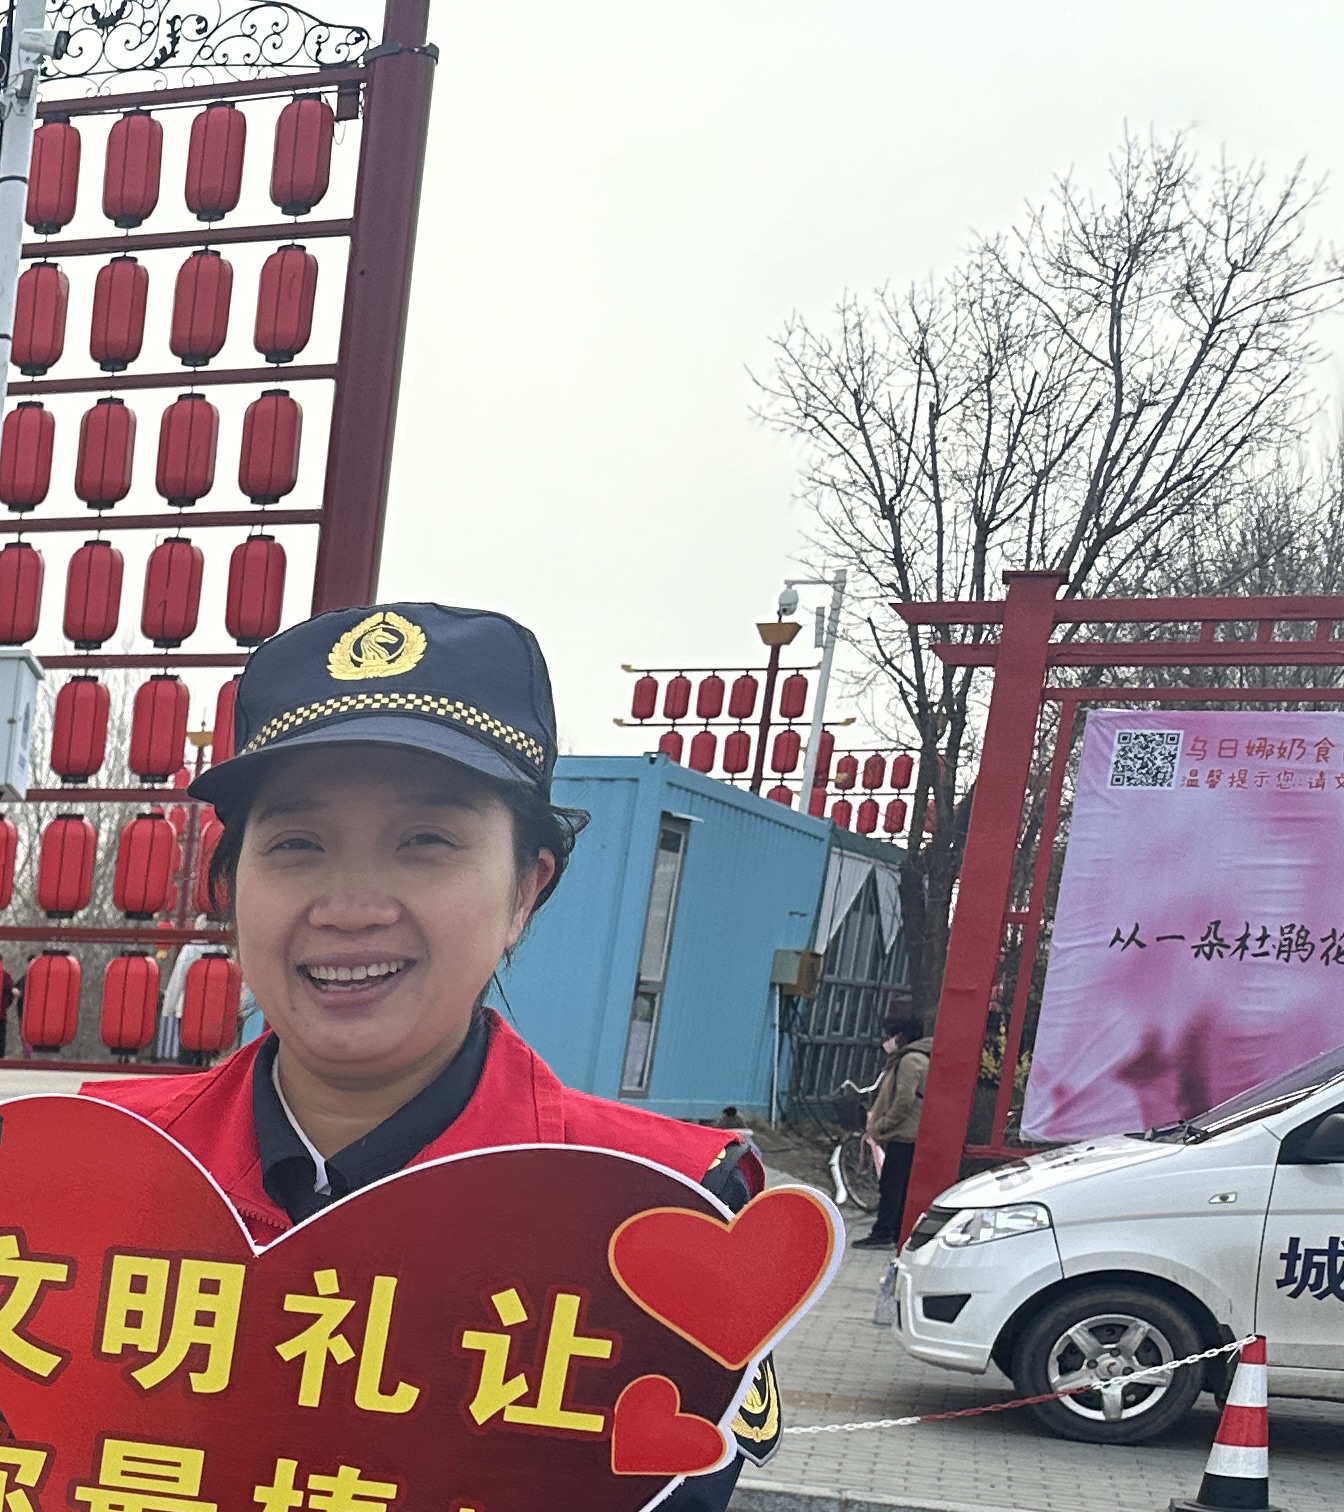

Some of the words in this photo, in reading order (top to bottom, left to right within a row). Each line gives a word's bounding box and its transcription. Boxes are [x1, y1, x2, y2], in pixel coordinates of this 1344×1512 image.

[1184, 735, 1344, 764] 乌日娜奶食
[1108, 919, 1344, 967] 从一朵杜鹃花
[1275, 1235, 1344, 1303] 城
